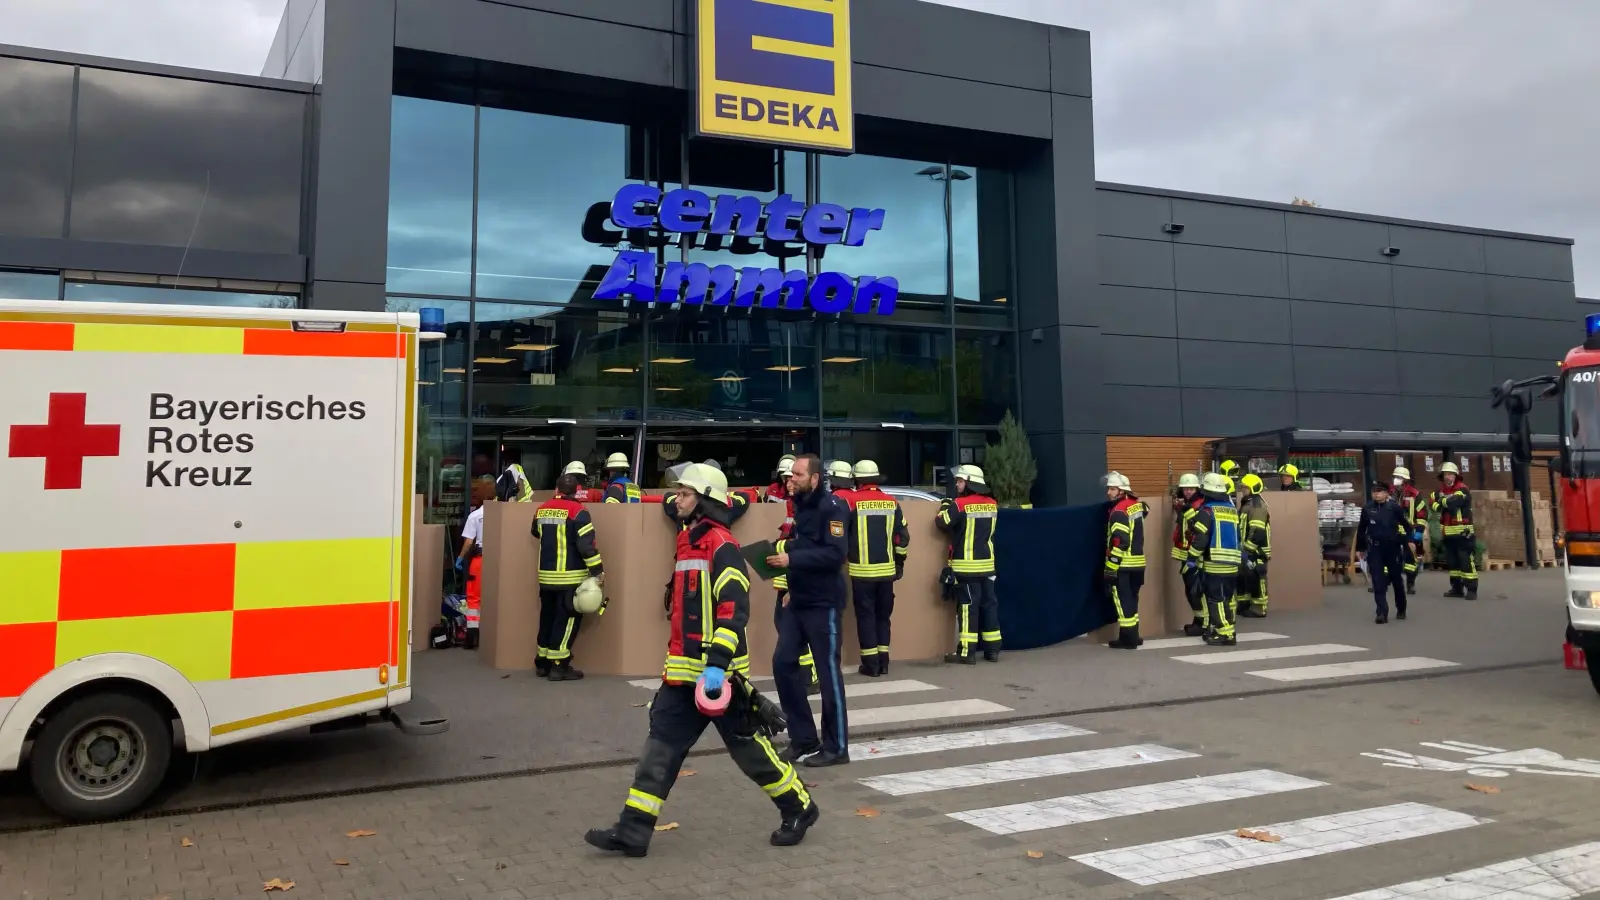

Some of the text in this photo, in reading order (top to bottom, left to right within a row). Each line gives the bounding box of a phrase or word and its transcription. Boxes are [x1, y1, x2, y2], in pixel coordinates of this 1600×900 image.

[715, 93, 840, 132] EDEKA
[610, 184, 886, 247] center
[592, 251, 900, 316] Ammon
[149, 392, 367, 426] Bayerisches
[147, 426, 254, 454] Rotes
[145, 460, 253, 488] Kreuz
[537, 508, 569, 518] FEUERWEHR
[857, 501, 895, 510] FEUERWEHR
